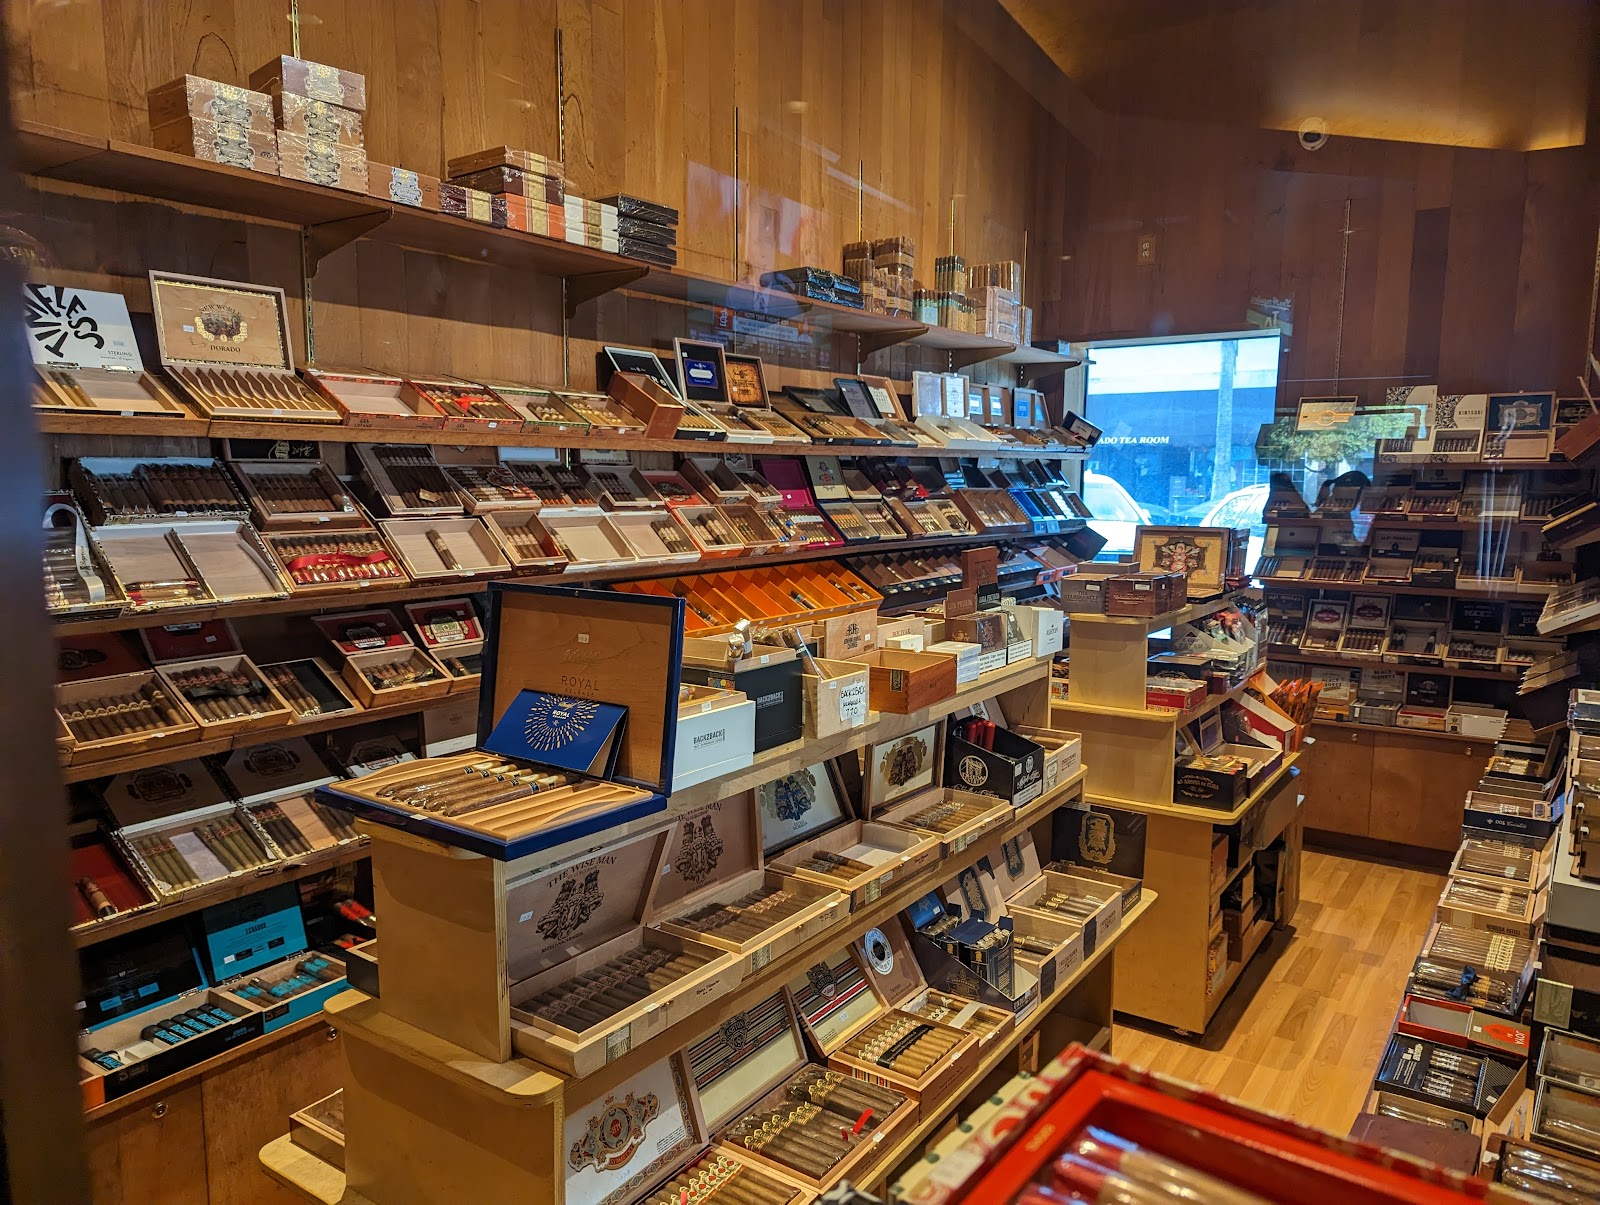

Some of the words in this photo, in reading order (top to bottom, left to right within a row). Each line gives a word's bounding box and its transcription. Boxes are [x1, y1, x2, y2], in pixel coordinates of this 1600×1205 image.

[200, 303, 215, 314] NEW
[210, 344, 241, 353] DORADO
[1119, 436, 1137, 444] TEA
[1139, 435, 1170, 444] ROOM
[561, 675, 599, 691] ROYAL
[565, 688, 595, 697] RELEASE
[552, 709, 570, 718] ROYAL
[845, 707, 859, 715] 770
[693, 729, 723, 745] BACK2BACK
[705, 802, 723, 812] MAN
[546, 869, 569, 889] THE
[570, 856, 597, 874] WISE
[596, 855, 618, 866] MAN
[245, 922, 267, 935] ECUADOR
[1514, 1030, 1525, 1045] JOYA
